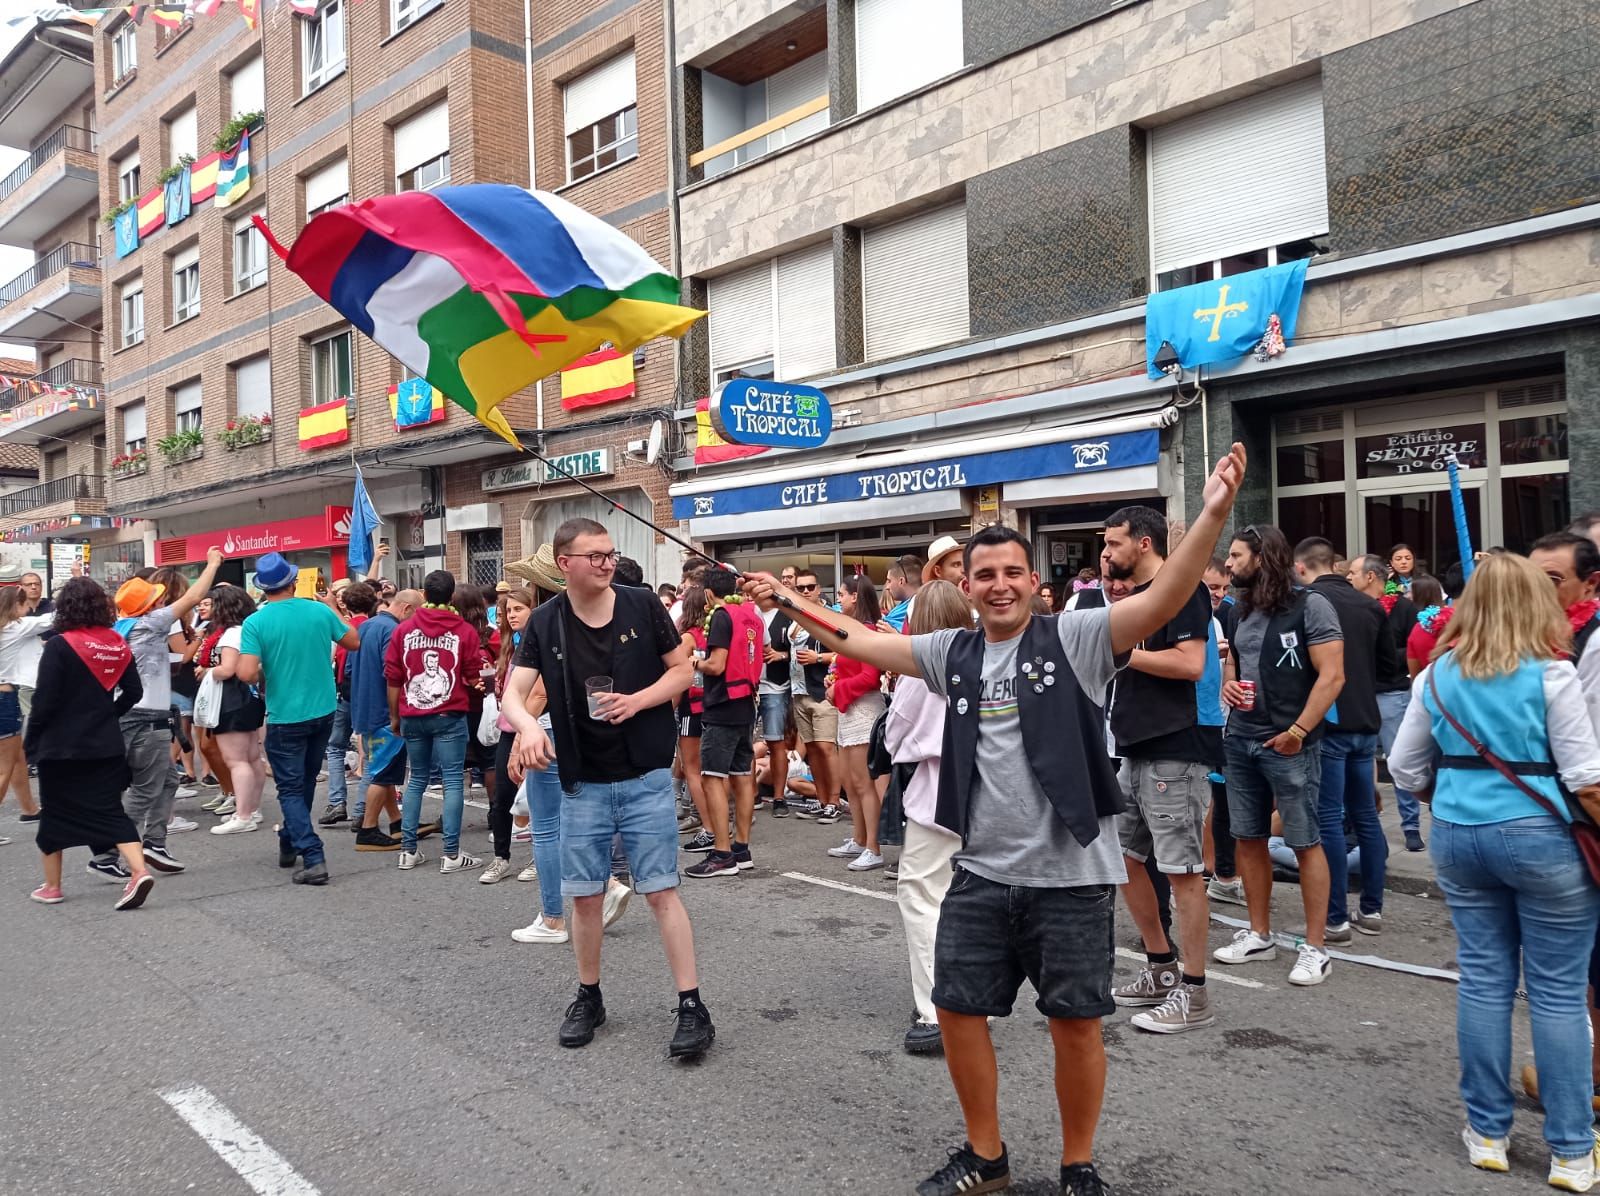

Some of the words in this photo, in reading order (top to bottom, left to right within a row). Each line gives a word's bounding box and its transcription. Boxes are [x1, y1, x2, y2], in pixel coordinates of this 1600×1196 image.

[745, 386, 793, 414] CAFÉ
[730, 405, 822, 437] TROPICAL
[1365, 440, 1477, 463] SENFRE
[1387, 431, 1454, 447] Edificio
[547, 451, 601, 480] SASTRE
[781, 478, 828, 506] CAFÉ
[858, 463, 967, 497] TROPICAL
[235, 529, 278, 552] Santander
